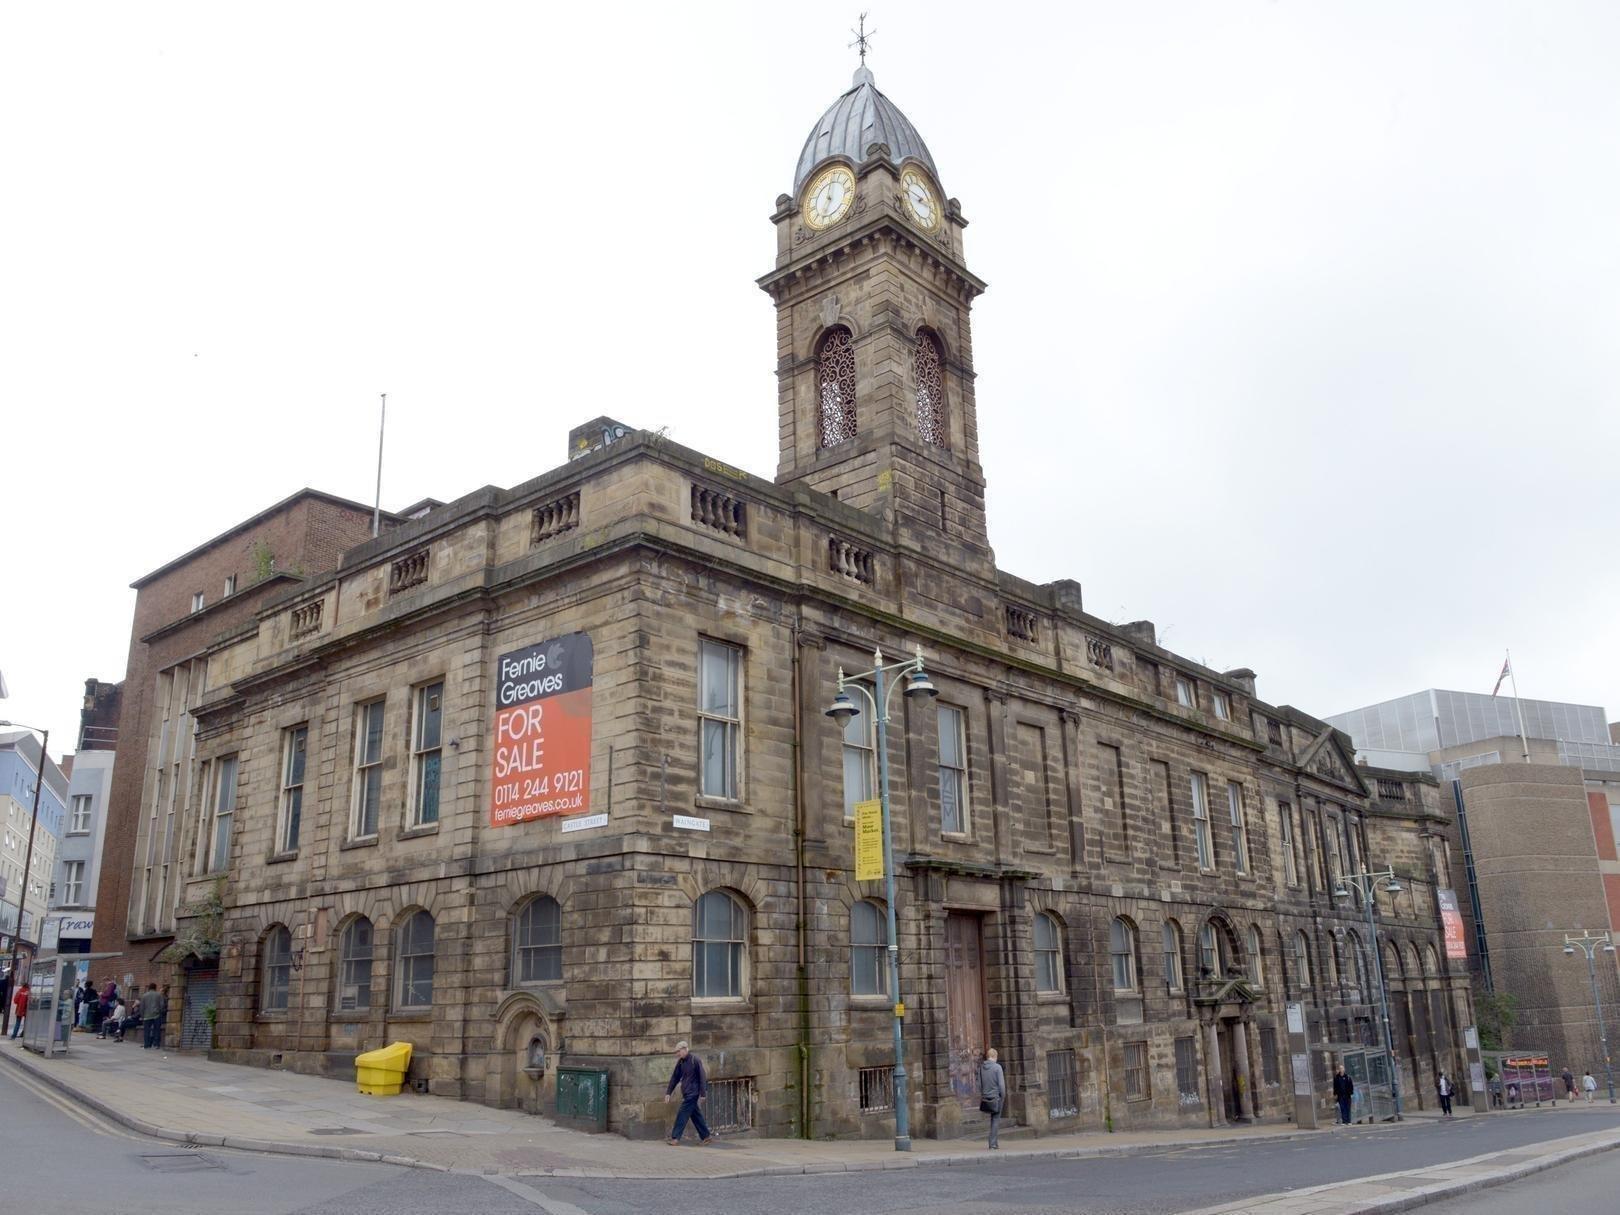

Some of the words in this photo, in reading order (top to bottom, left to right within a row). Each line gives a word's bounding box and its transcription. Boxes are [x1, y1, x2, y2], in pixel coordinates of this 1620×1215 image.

[502, 652, 546, 681] Fernie
[500, 673, 563, 704] Greaves
[498, 705, 543, 743] FOR
[496, 738, 544, 777] SALE
[495, 781, 519, 805] 0114
[524, 775, 549, 799] 244
[554, 769, 583, 793] 9121
[495, 793, 583, 821] ferniegreaves.co.uk
[584, 816, 603, 828] STREET
